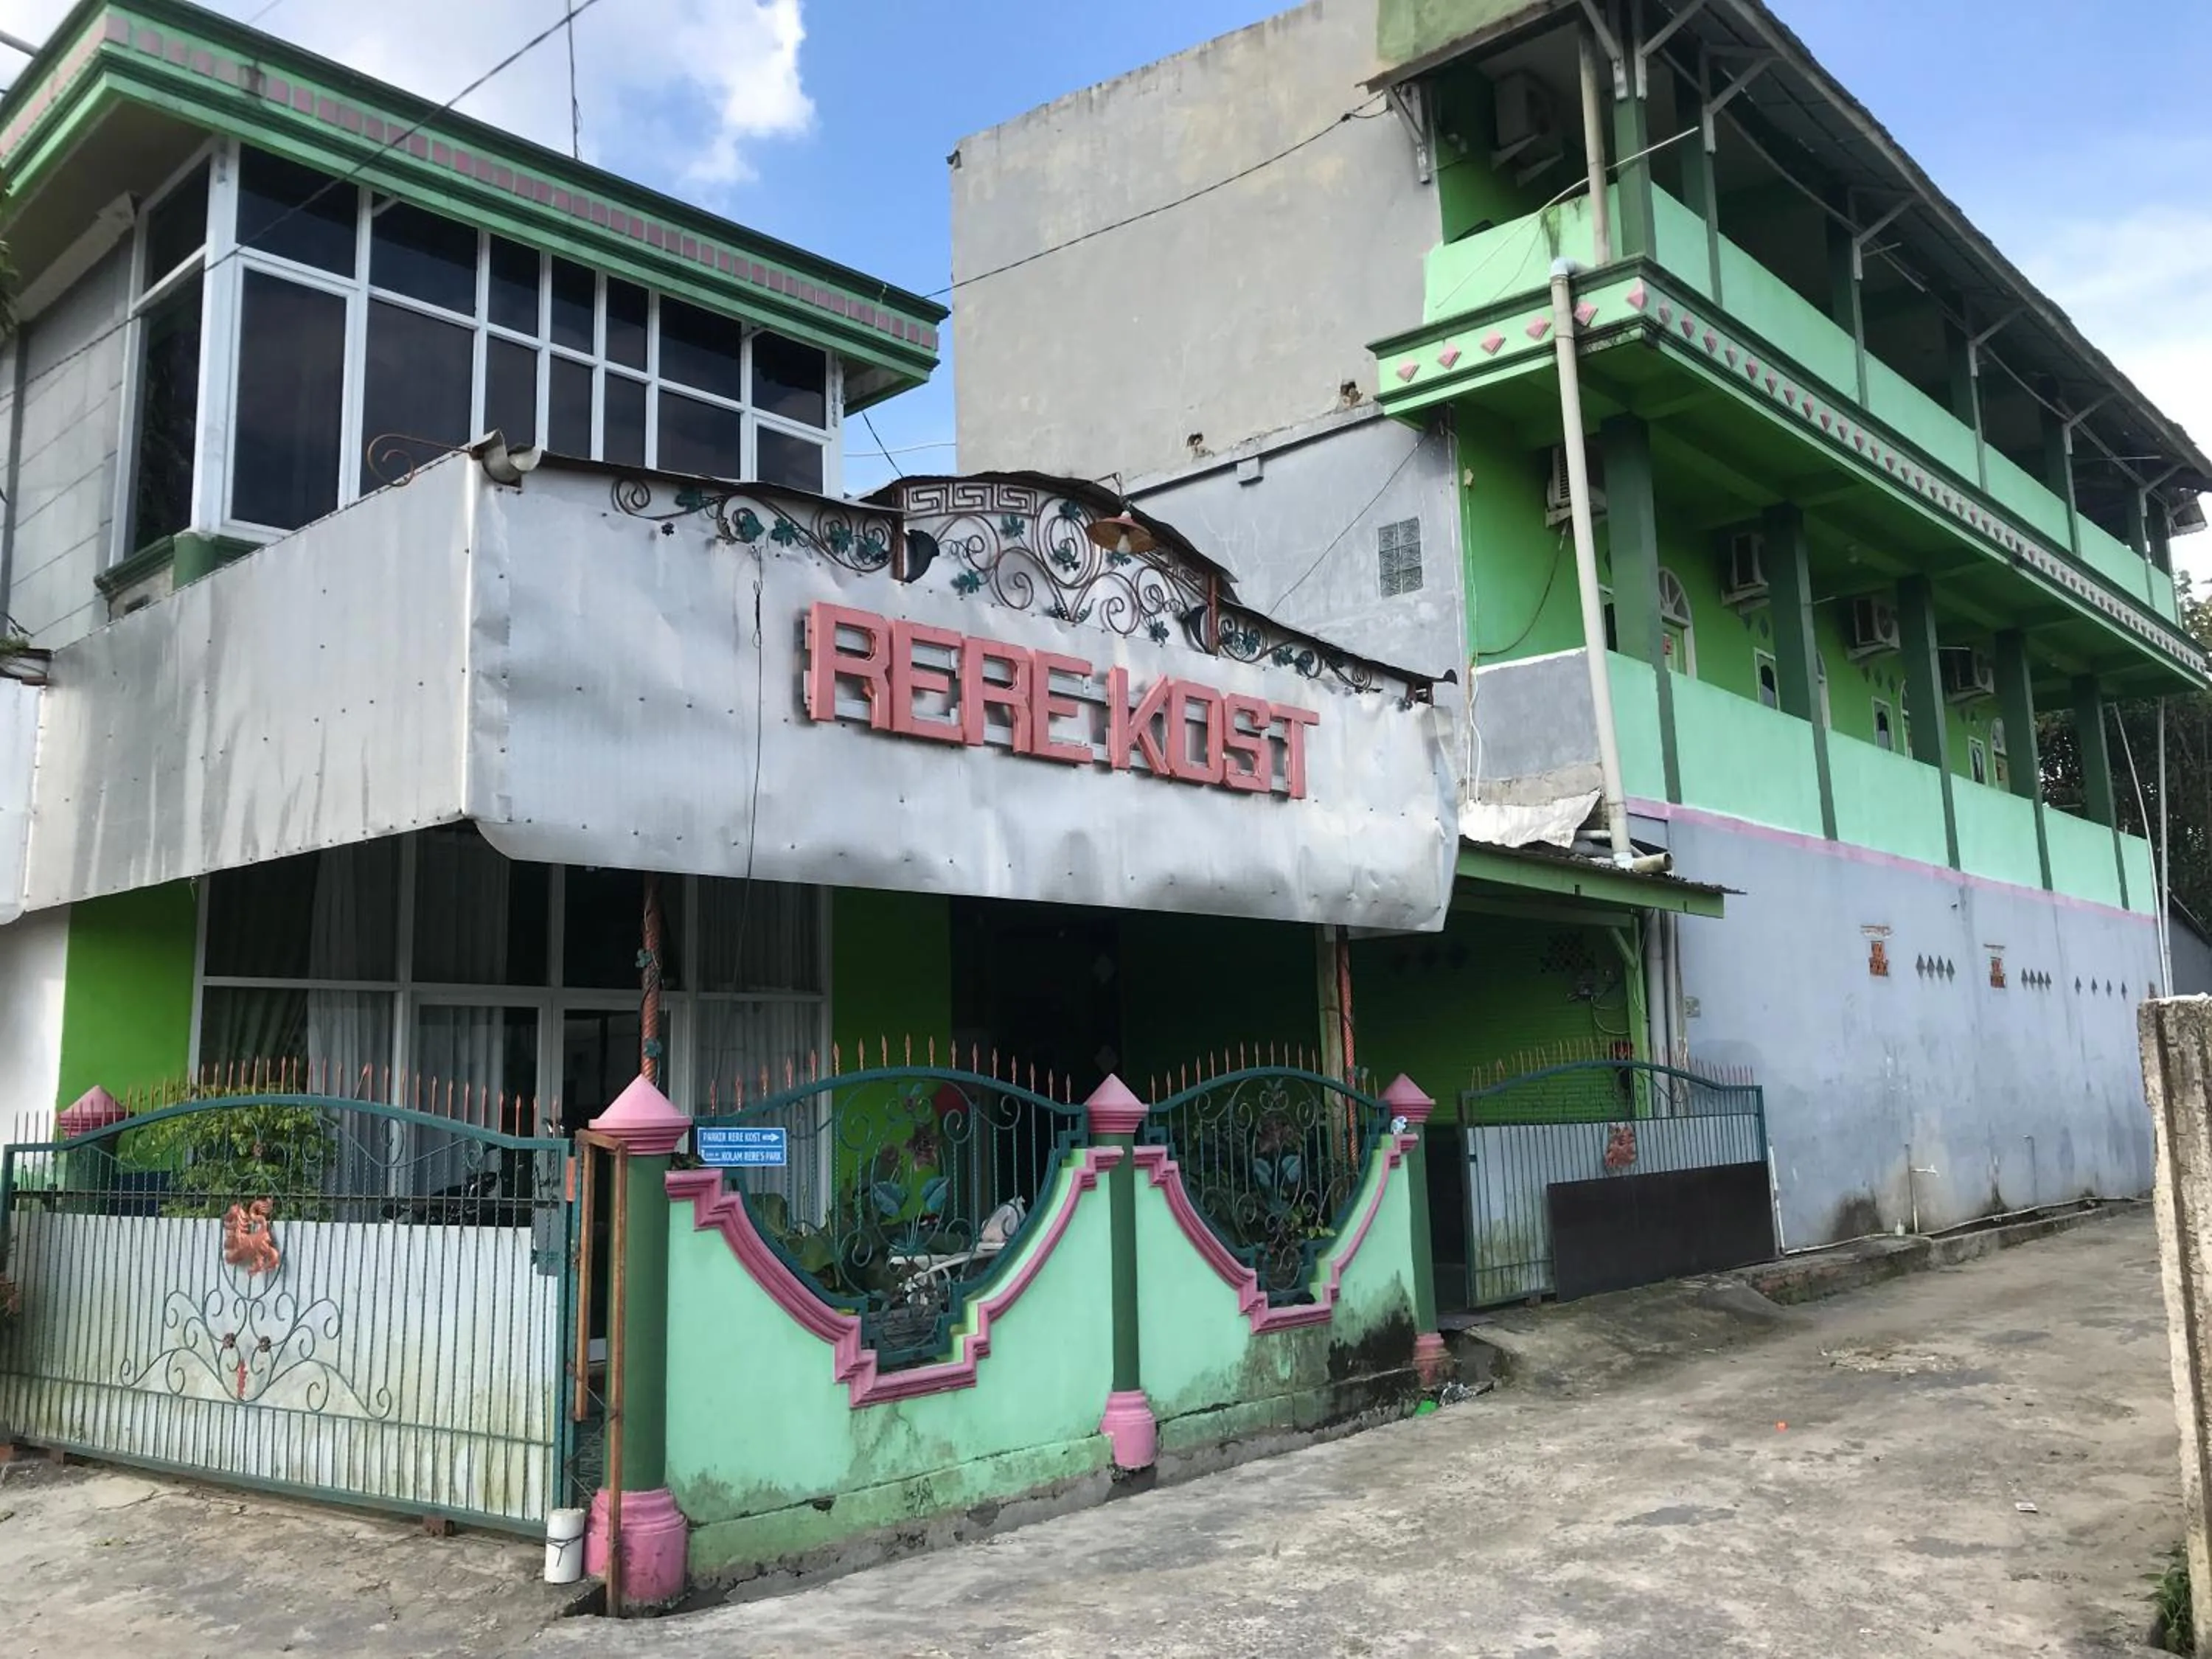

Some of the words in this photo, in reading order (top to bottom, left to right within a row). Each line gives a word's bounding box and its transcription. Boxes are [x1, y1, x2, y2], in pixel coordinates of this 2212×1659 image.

[809, 601, 1093, 765] RERE
[1107, 665, 1320, 800] KOST
[728, 1132, 744, 1142] RERE
[745, 1132, 761, 1142] KOST
